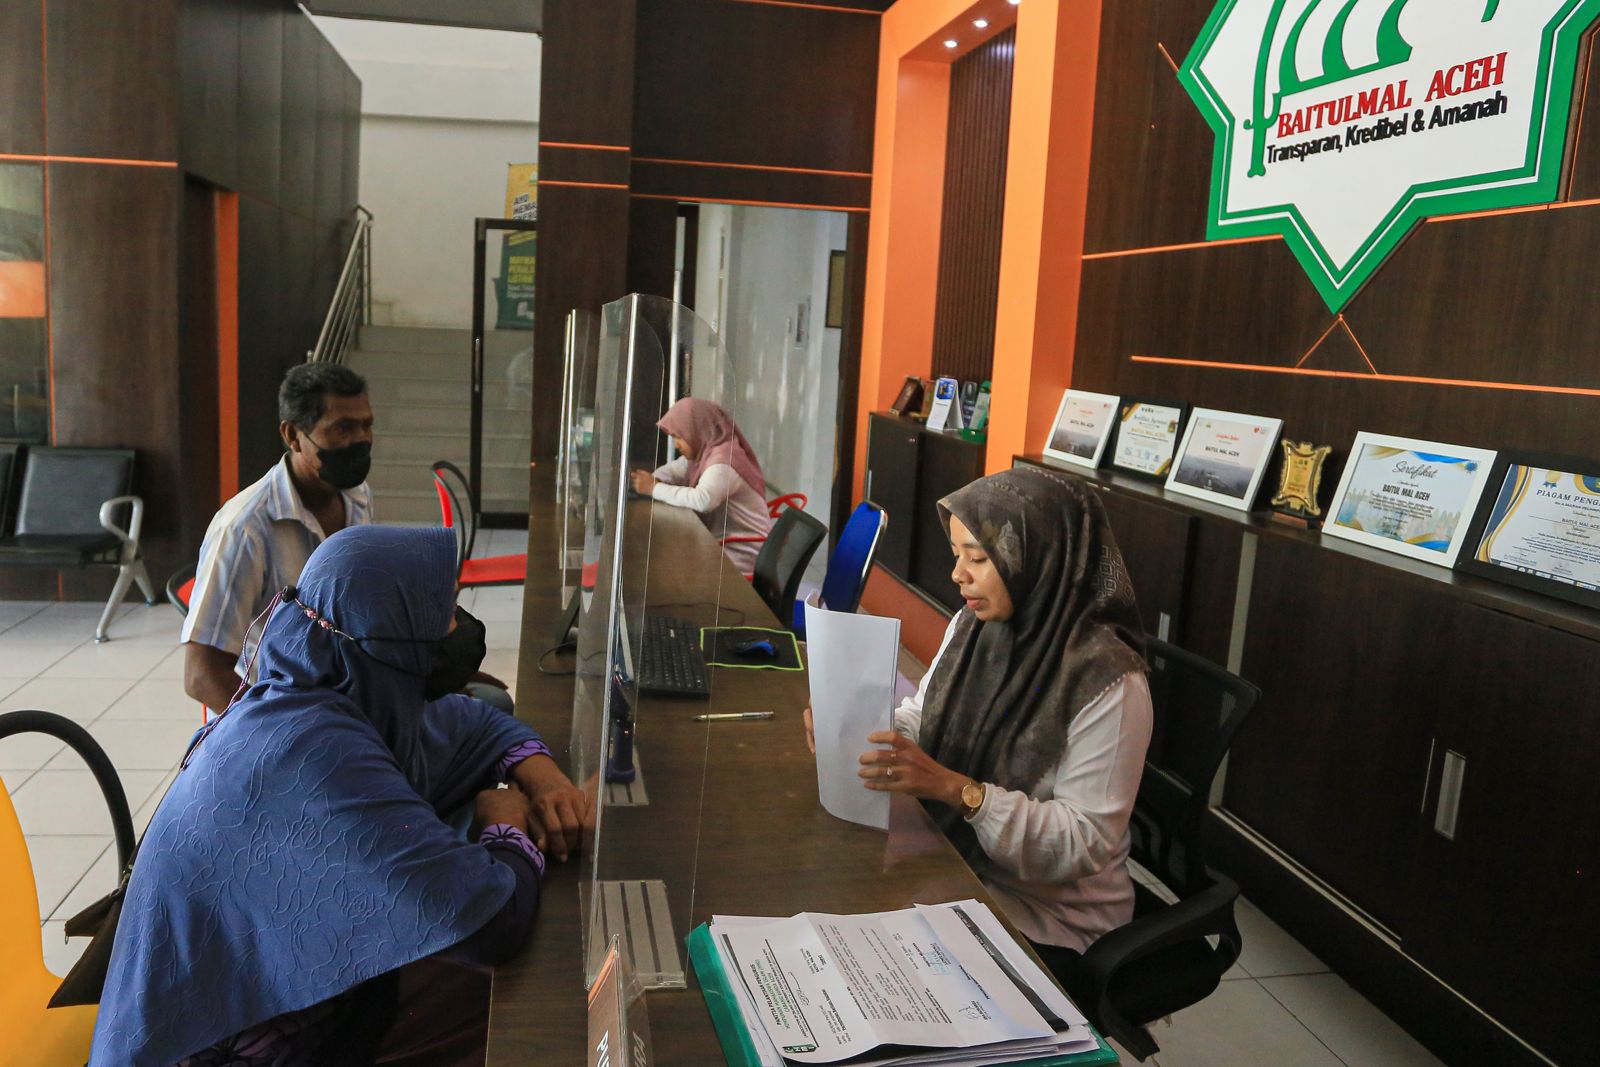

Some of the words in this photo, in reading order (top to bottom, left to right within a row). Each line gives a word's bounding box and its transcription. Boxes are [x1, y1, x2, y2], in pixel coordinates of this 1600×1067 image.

[1277, 80, 1412, 138] BAITULMAL
[1424, 52, 1508, 101] ACEH
[1267, 135, 1344, 164] Transparan,
[1345, 112, 1408, 148] Kredibel
[1411, 109, 1424, 132] &
[1428, 91, 1508, 130] Amanah
[1392, 460, 1438, 480] Sertifikat
[1382, 483, 1400, 495] BAITUL
[1401, 487, 1413, 498] MAL
[1415, 489, 1431, 502] ACEH
[1536, 489, 1571, 501] PIAGAM
[1573, 494, 1600, 506] PENG
[750, 964, 762, 984] PENGURUS
[770, 1008, 782, 1025] PANITIA
